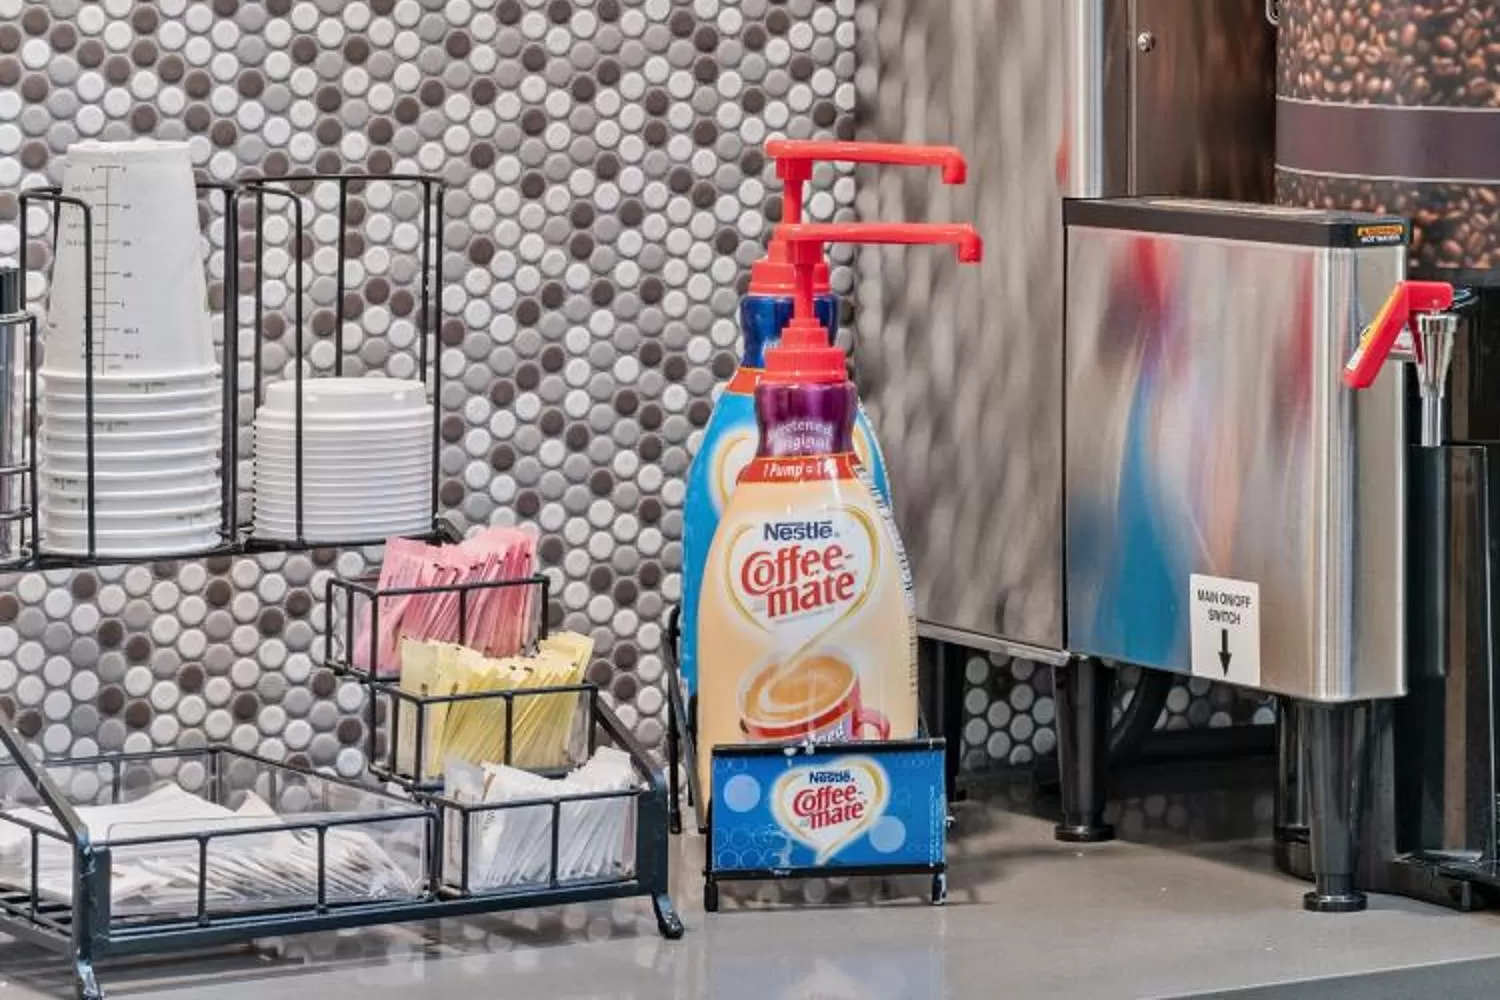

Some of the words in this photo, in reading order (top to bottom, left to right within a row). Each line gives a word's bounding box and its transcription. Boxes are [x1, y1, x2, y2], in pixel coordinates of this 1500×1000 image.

[769, 461, 803, 477] Pump
[767, 572, 856, 618] mate
[809, 800, 865, 830] mate
